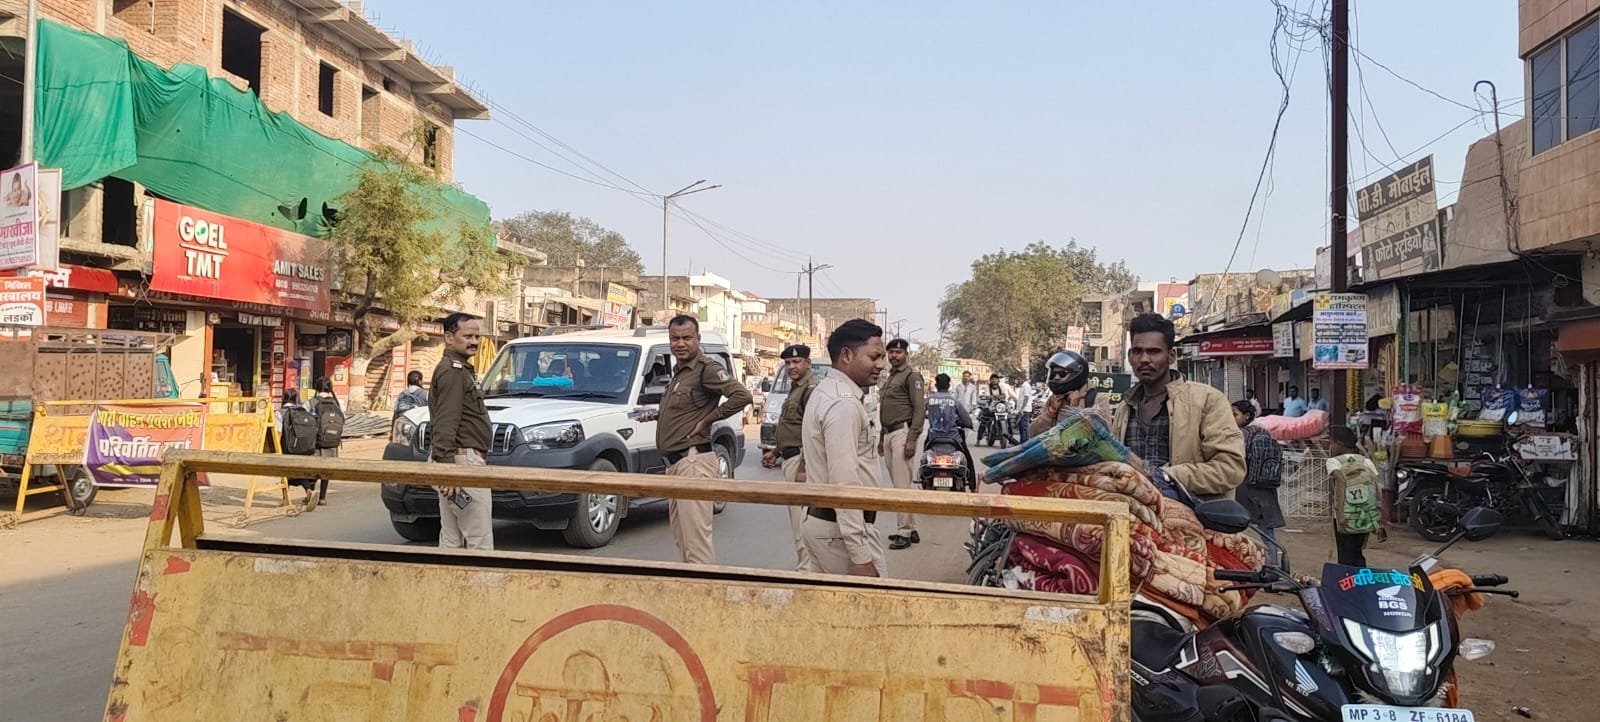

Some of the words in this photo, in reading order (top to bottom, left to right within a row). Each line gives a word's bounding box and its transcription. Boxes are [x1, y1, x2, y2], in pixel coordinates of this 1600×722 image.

[1387, 163, 1431, 198] मोबाईल
[179, 216, 227, 249] GOEL
[1375, 239, 1393, 262] फोटो
[1394, 228, 1422, 261] स्टूडियो
[185, 251, 224, 279] TMT
[274, 260, 297, 276] AMIT
[298, 264, 325, 281] SALES
[118, 411, 146, 428] वाहन
[147, 408, 171, 429] प्रवेश
[99, 435, 161, 458] परिवर्तित
[1349, 489, 1363, 500] Y!
[1378, 601, 1408, 610] BGS
[1349, 708, 1369, 721] MP
[1409, 710, 1426, 722] ZF
